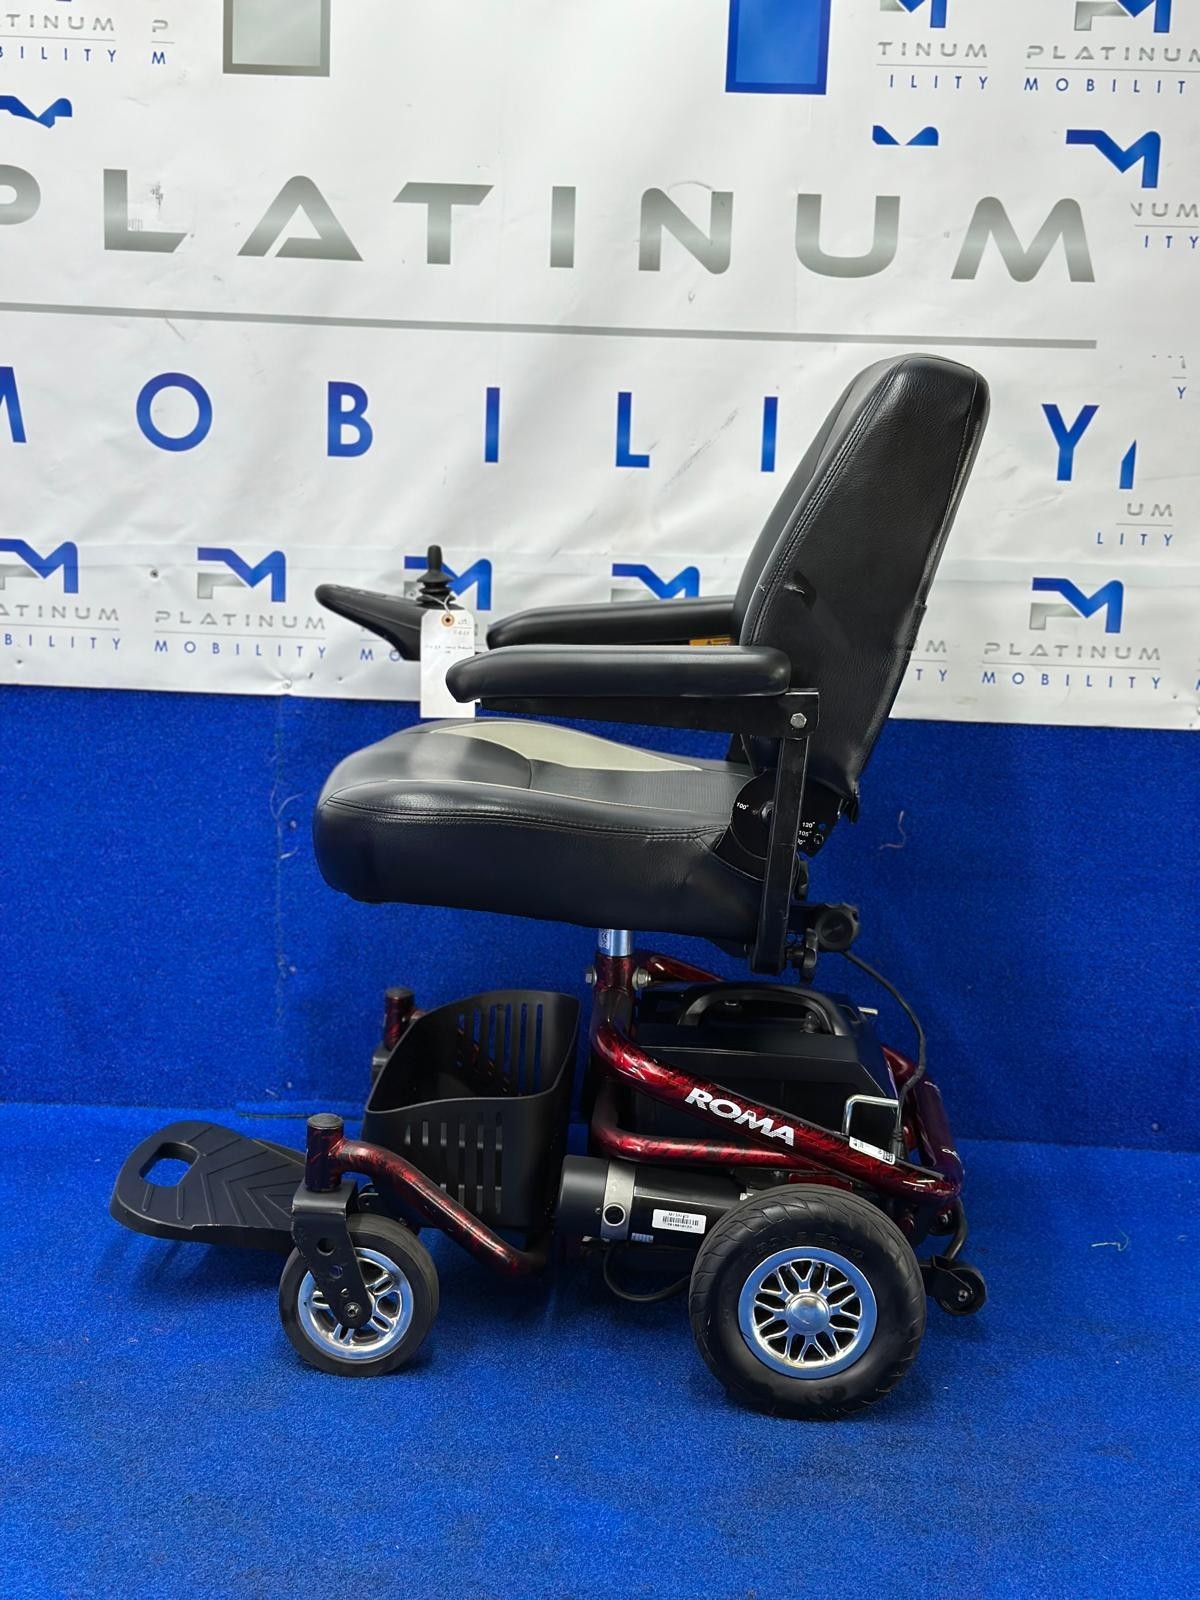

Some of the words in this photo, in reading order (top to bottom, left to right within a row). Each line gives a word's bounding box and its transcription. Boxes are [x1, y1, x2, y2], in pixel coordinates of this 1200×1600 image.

[0, 14, 115, 31] TINUM
[154, 610, 326, 630] PLATINUM
[154, 640, 327, 659] MOBILITY
[984, 642, 1160, 661] PLATINUM
[981, 671, 1161, 690] MOBILITY
[684, 1087, 795, 1147] ROMA
